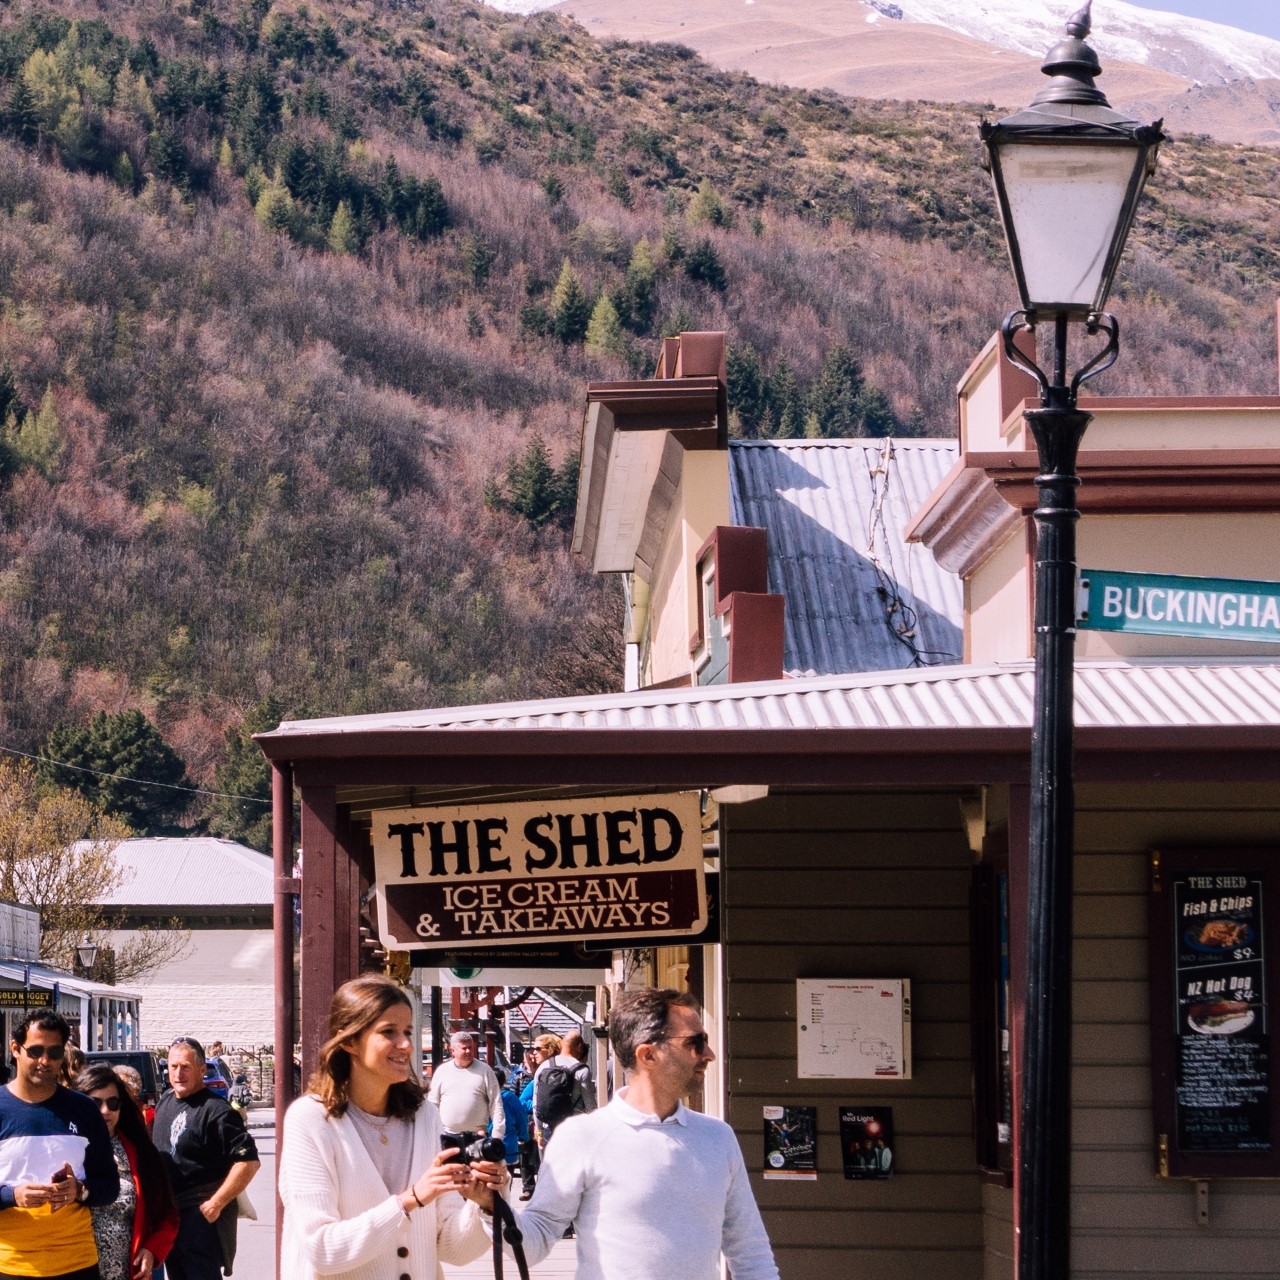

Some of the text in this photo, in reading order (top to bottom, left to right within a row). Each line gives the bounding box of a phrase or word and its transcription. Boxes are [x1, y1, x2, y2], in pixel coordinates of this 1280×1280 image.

[1103, 585, 1280, 629] BUCKINGHA
[388, 807, 683, 878] THE SHED
[1188, 876, 1247, 888] THE SHED
[443, 877, 640, 910] ICE CREAM
[1183, 901, 1207, 916] Fish
[1209, 899, 1218, 912] &
[1219, 896, 1253, 911] Chips
[416, 913, 440, 937] &
[455, 901, 670, 936] TAKEAWAYS
[18, 991, 50, 1000] NGGET
[1188, 976, 1252, 996] NZ Hot Dog
[857, 1115, 874, 1123] Light
